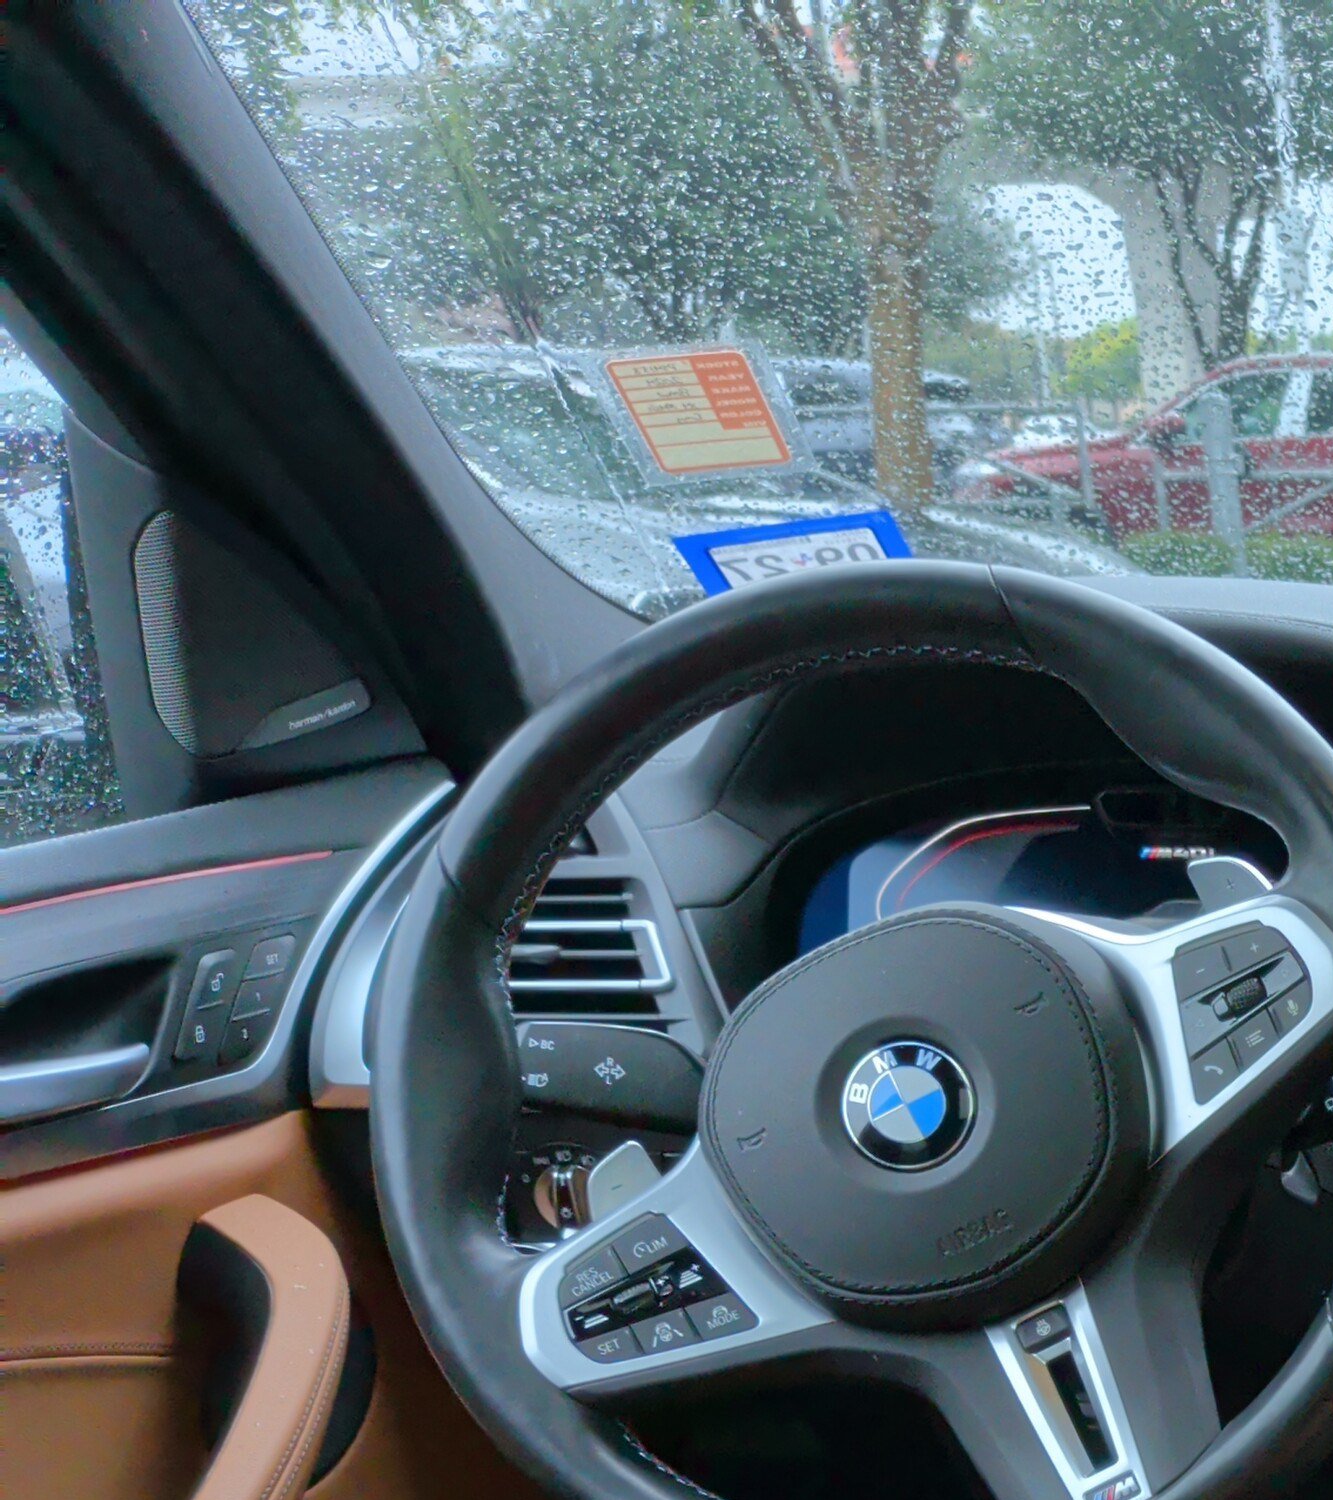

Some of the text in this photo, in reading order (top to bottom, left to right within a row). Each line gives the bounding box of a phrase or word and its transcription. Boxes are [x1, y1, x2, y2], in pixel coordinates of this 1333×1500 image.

[540, 1039, 556, 1051] BC
[848, 1048, 942, 1104] BMW
[645, 1235, 670, 1254] LIM
[571, 1271, 615, 1297] CANCEL
[576, 1266, 599, 1284] RES
[705, 1309, 741, 1330] MODE
[596, 1337, 621, 1356] SET
